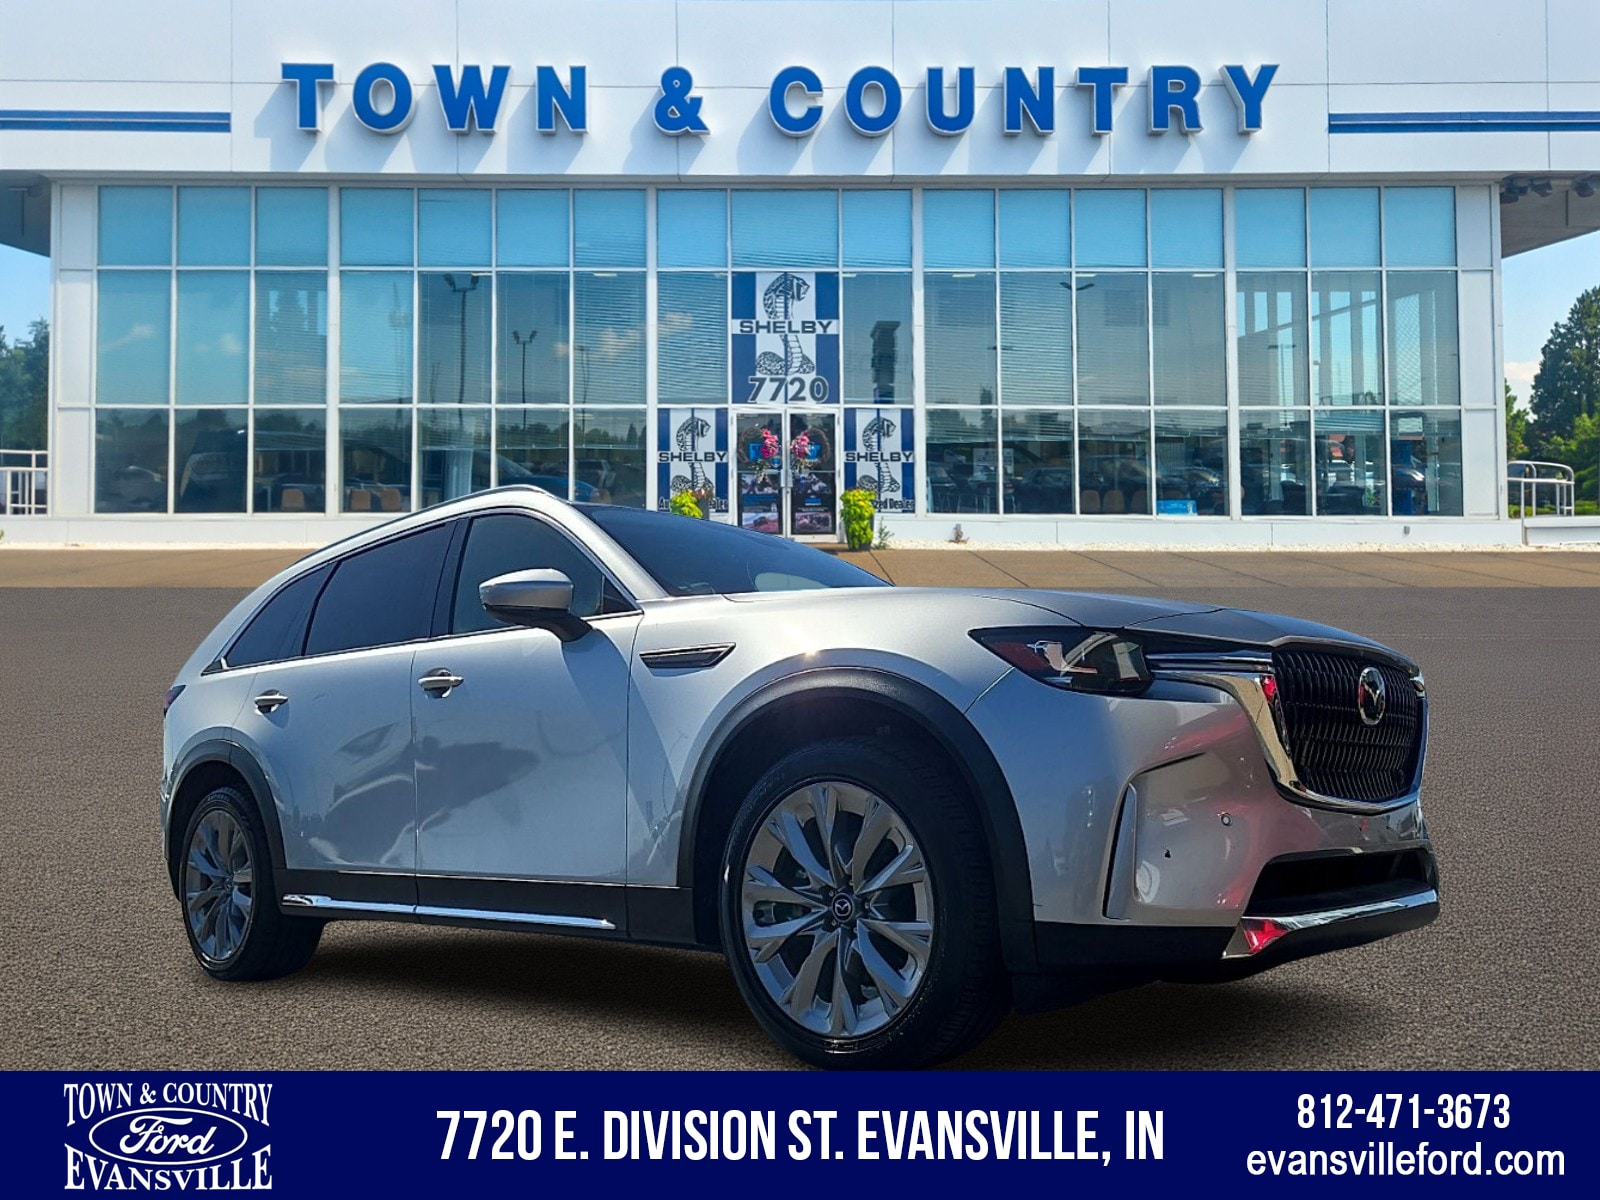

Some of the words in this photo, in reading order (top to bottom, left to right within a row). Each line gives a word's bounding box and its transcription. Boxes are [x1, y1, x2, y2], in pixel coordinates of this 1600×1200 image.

[281, 63, 587, 137] TOWN
[653, 66, 710, 136] &
[768, 64, 1280, 138] COUNTRY
[739, 320, 833, 334] SHELBY
[749, 376, 828, 402] 7720
[658, 451, 727, 462] SHELBY
[845, 451, 914, 462] SHELBY
[889, 497, 915, 510] Dealer
